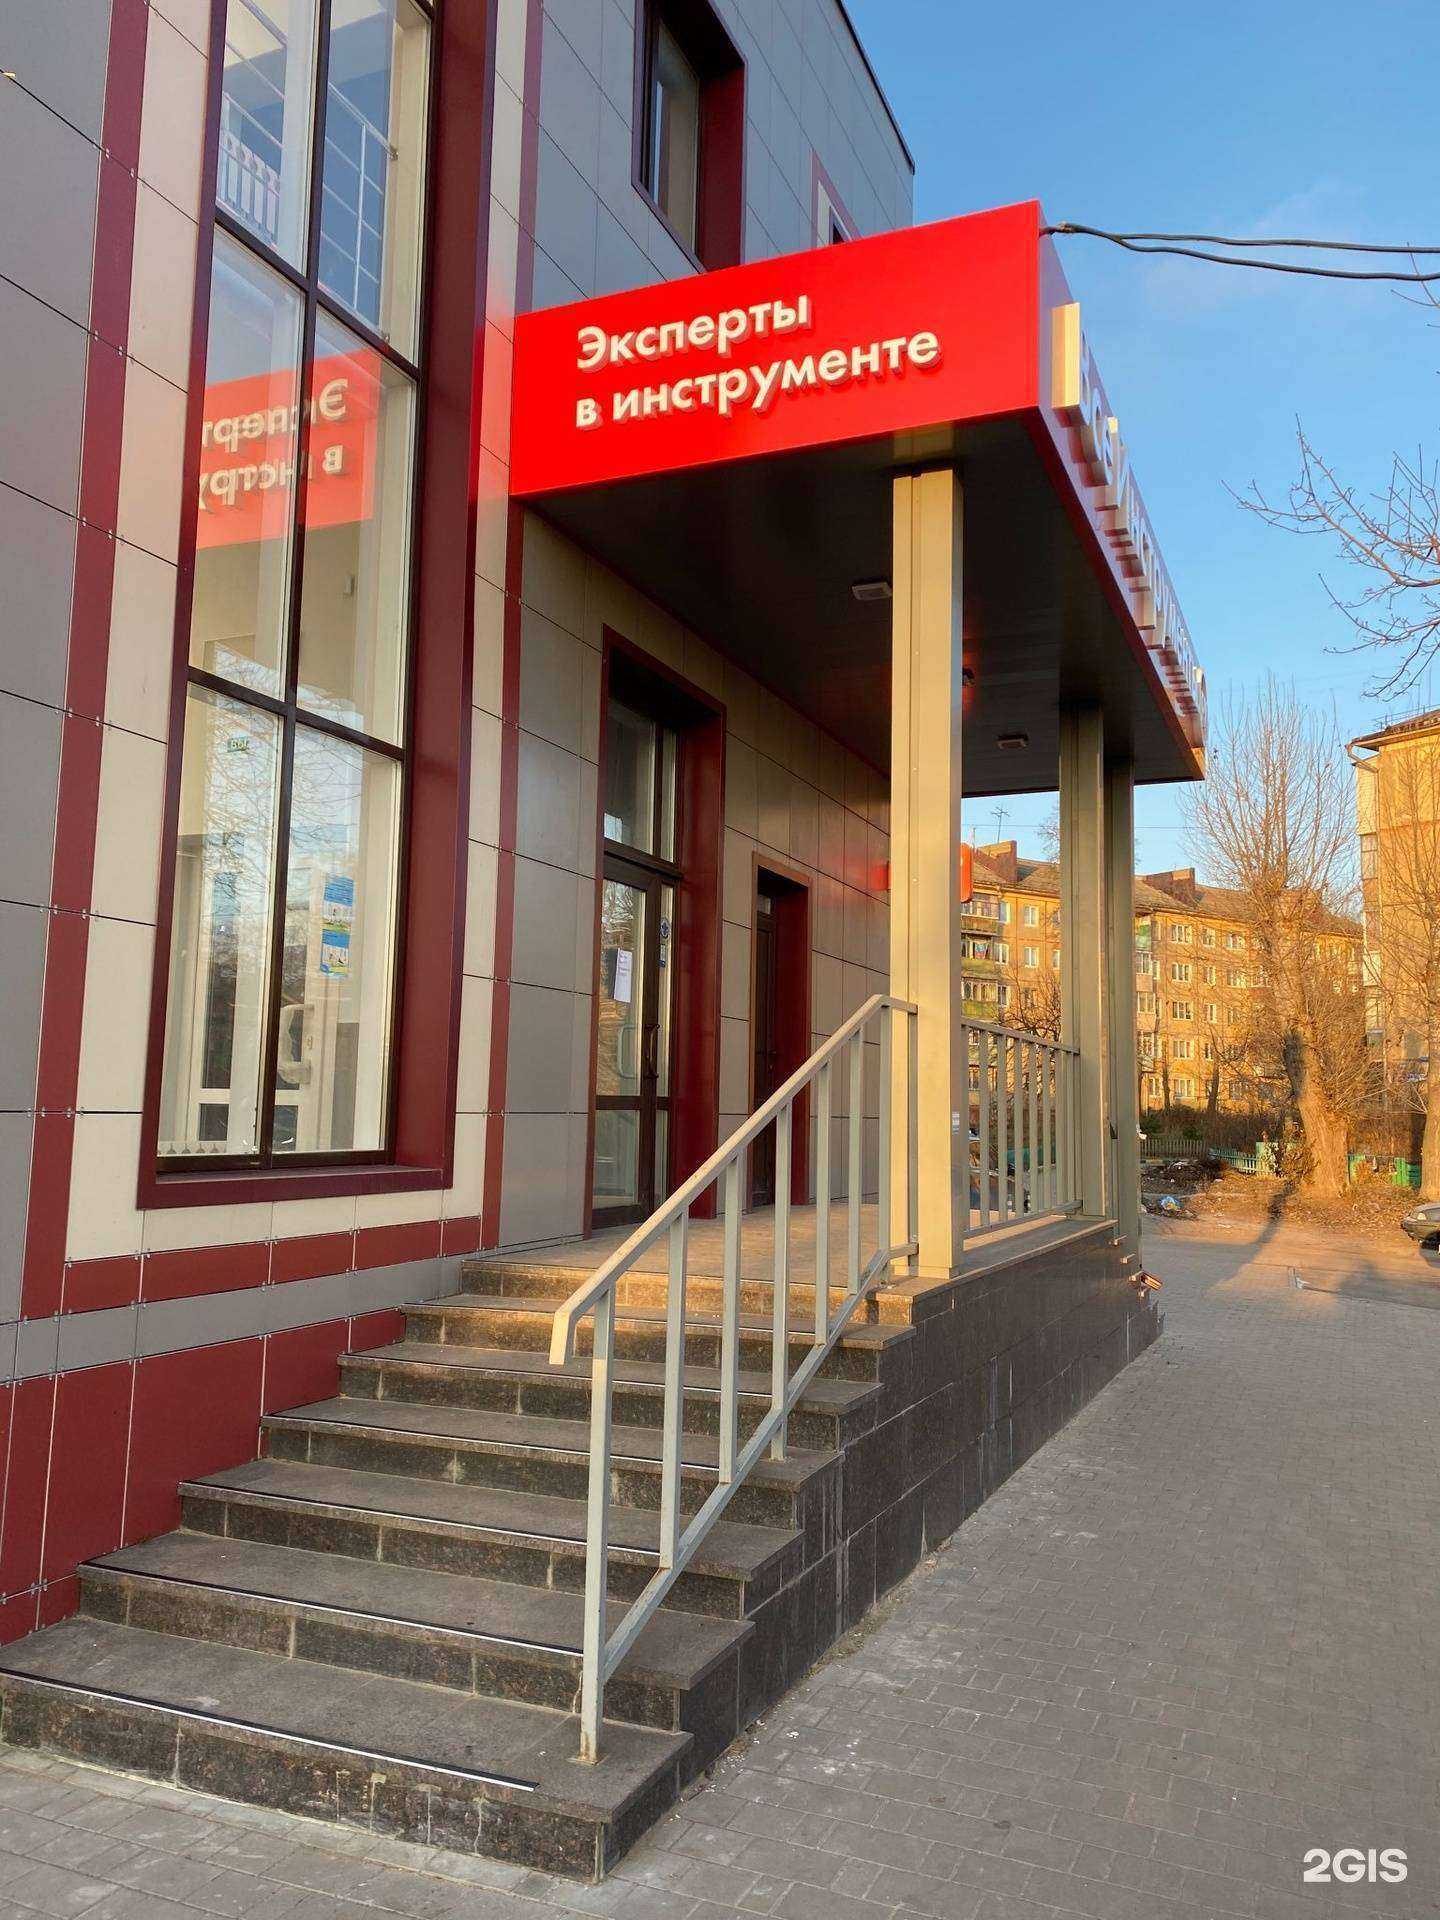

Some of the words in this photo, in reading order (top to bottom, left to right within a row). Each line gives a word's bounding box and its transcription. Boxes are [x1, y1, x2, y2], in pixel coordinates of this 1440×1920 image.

[576, 294, 812, 371] Эксперты
[575, 398, 601, 430] в
[612, 330, 942, 418] инструменте
